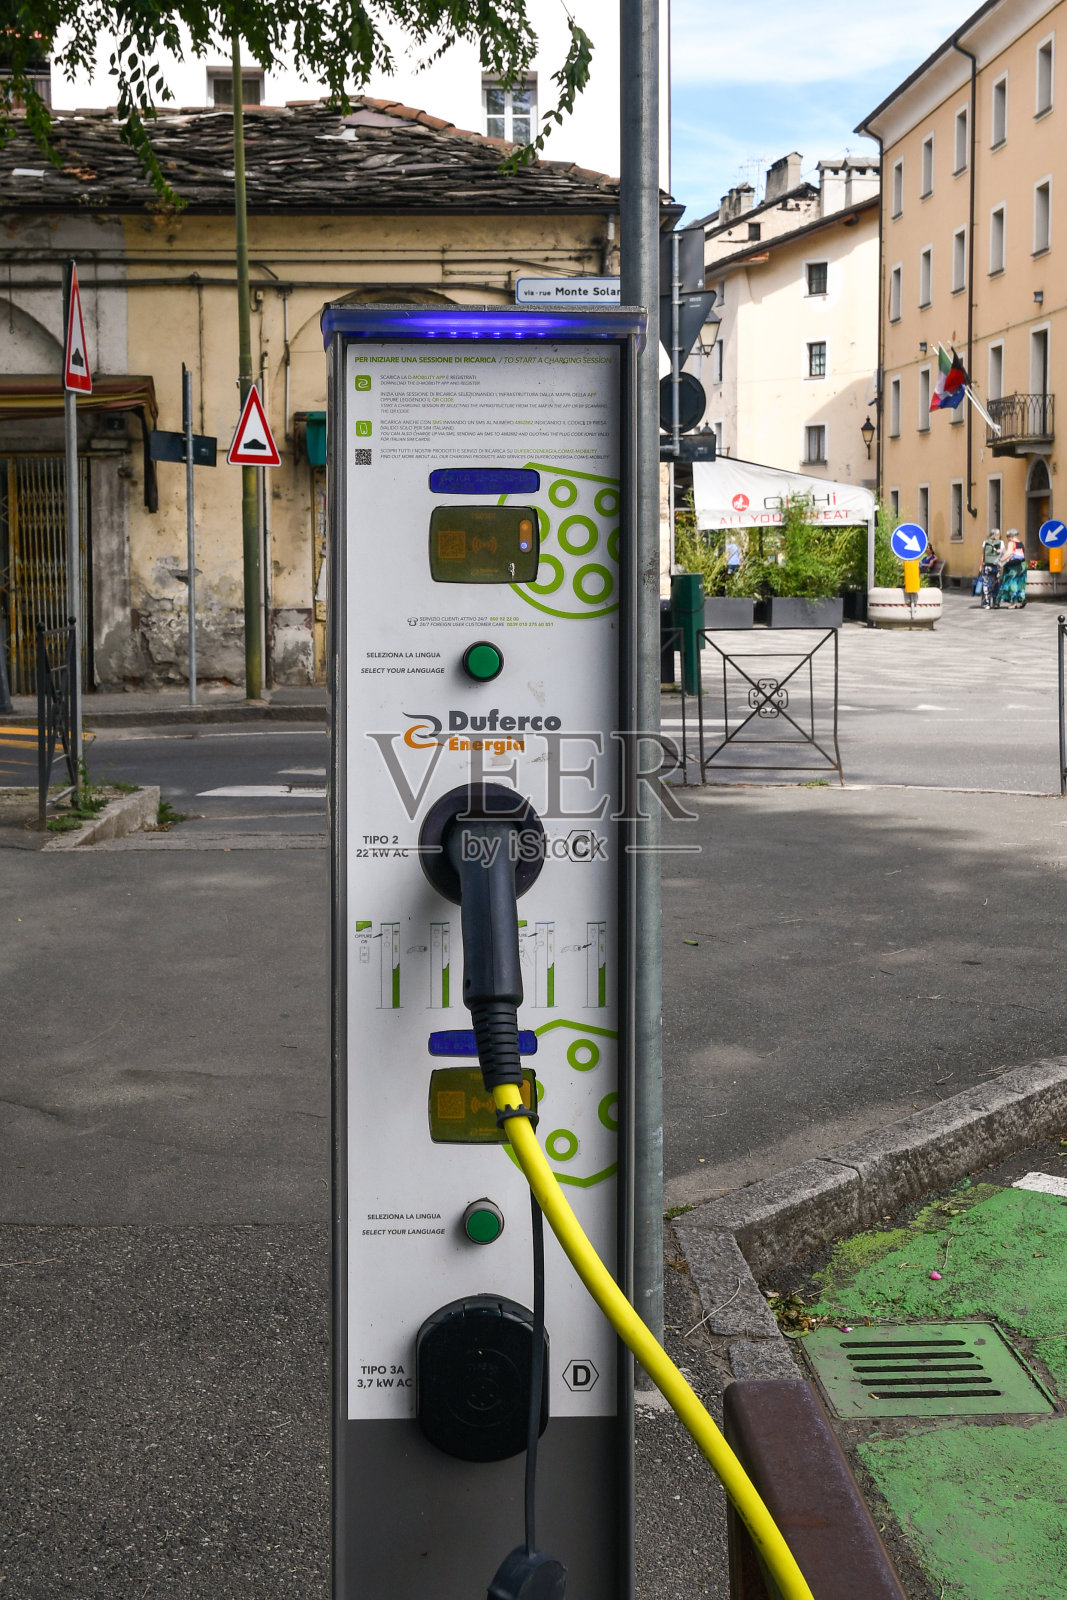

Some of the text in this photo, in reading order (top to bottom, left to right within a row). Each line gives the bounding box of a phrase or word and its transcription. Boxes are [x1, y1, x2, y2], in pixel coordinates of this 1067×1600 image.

[556, 287, 589, 296] Monte
[751, 514, 783, 523] YOU
[824, 510, 850, 520] EAT
[449, 709, 562, 731] Duferco
[449, 736, 525, 755] Energia
[363, 835, 399, 844] TIPO 2
[572, 835, 590, 858] C
[356, 849, 408, 857] 22 kW AC
[361, 1366, 404, 1374] TIPO 3A
[573, 1365, 590, 1386] D
[357, 1378, 412, 1389] 3,7 kW AC
